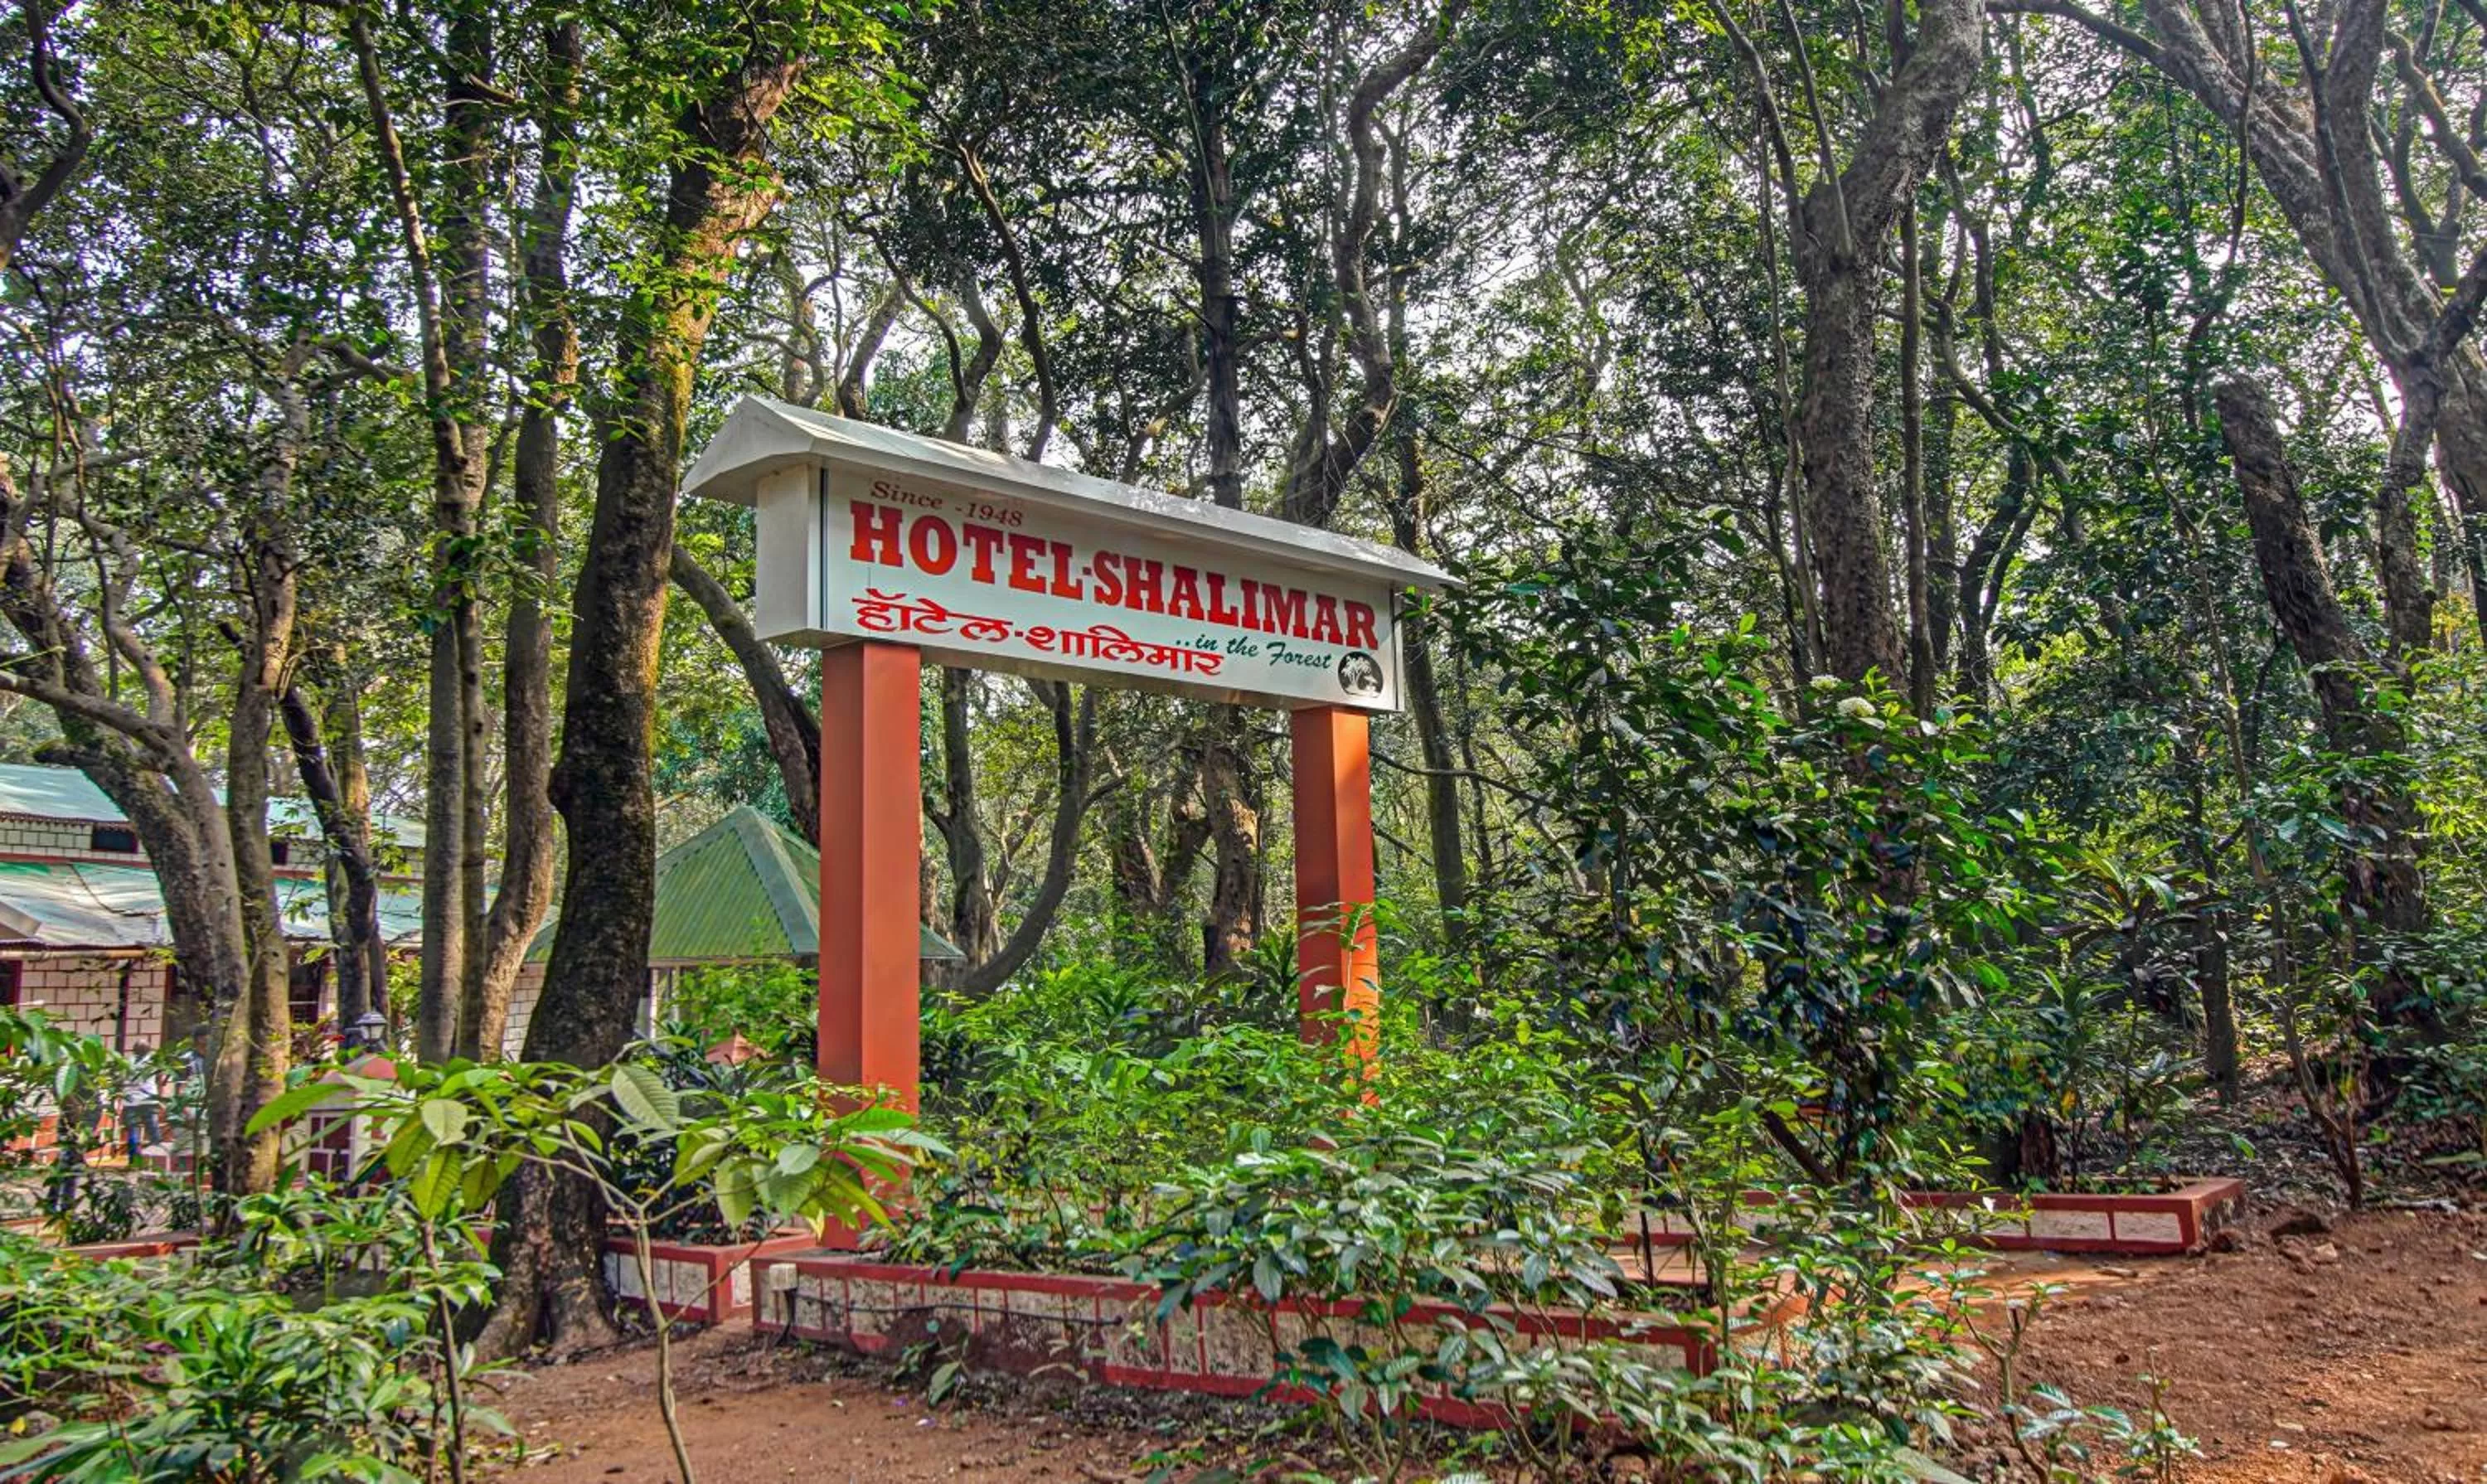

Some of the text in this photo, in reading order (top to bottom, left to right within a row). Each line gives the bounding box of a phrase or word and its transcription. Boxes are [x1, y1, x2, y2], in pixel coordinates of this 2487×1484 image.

[870, 481, 943, 511] Since
[1227, 636, 1260, 657] the
[1266, 642, 1333, 669] Forest
